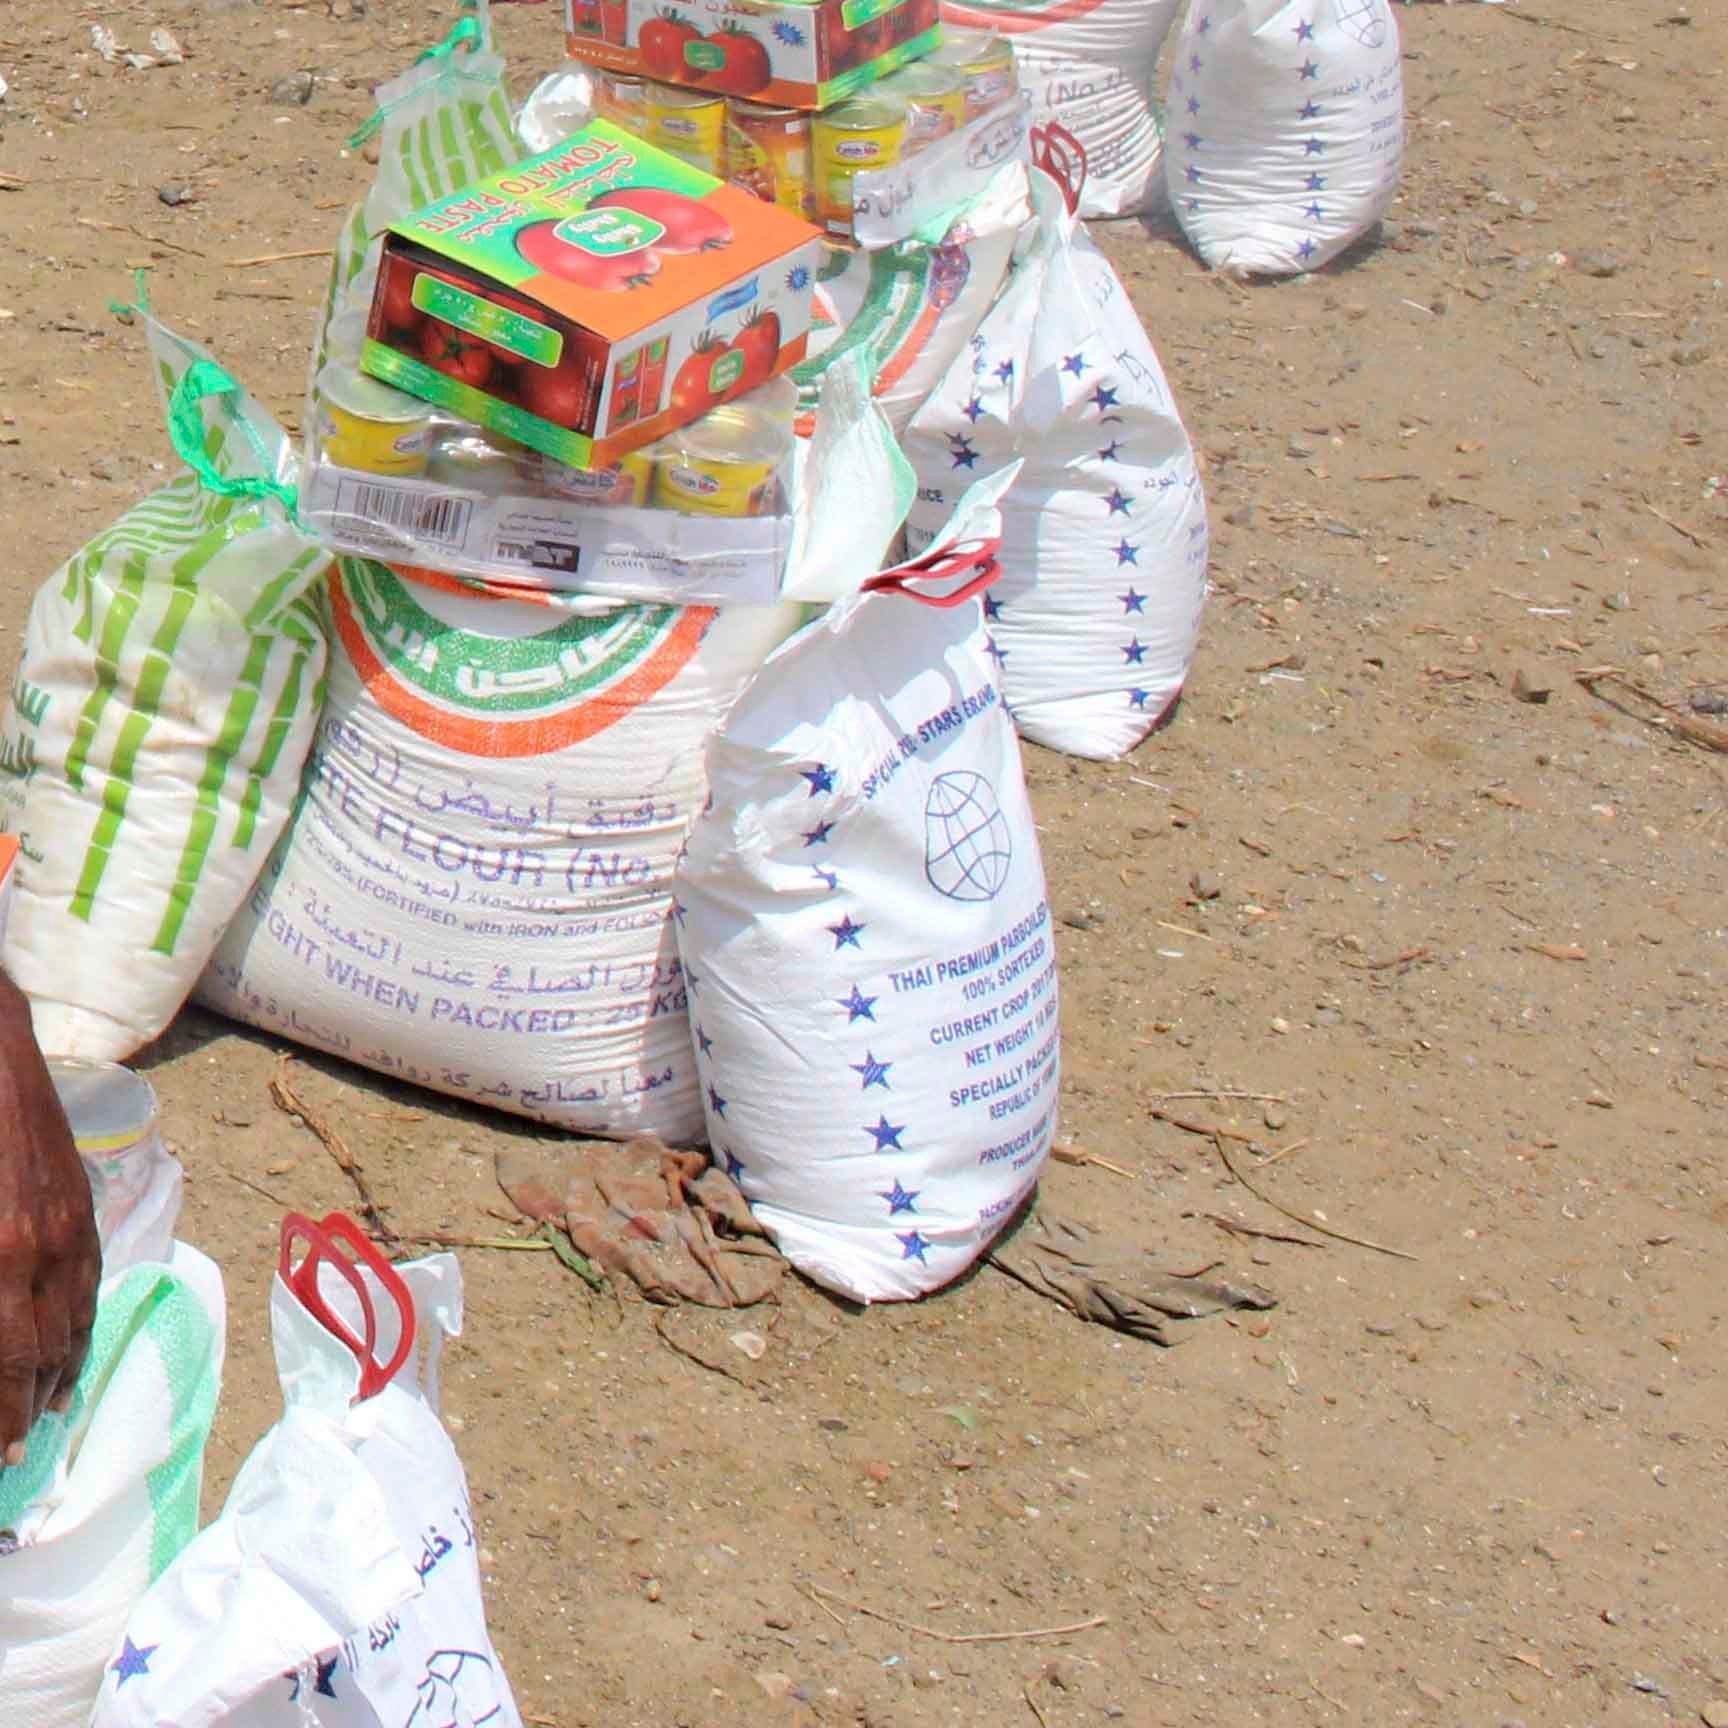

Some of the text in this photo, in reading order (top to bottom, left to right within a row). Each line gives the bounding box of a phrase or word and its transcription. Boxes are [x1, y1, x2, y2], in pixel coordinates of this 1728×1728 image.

[415, 137, 619, 234] TOMATO PASTE
[372, 809, 546, 888] FLOUR
[356, 875, 458, 928] (FORTIFIED
[463, 916, 504, 935] with
[506, 917, 561, 940] IRON
[561, 919, 598, 939] and
[888, 943, 1000, 993] THAI PREMIUM
[961, 937, 1046, 1003] 100% SORTEXED
[324, 957, 422, 1016] WHEN
[430, 999, 577, 1035] PACKED
[929, 992, 1030, 1046] CURRENT CROP
[964, 1021, 1034, 1069] NET WEIGHT
[949, 1065, 1024, 1107] SPECIALLY
[988, 1085, 1032, 1121] REPUBLIC
[978, 1131, 1032, 1166] PRODUCER
